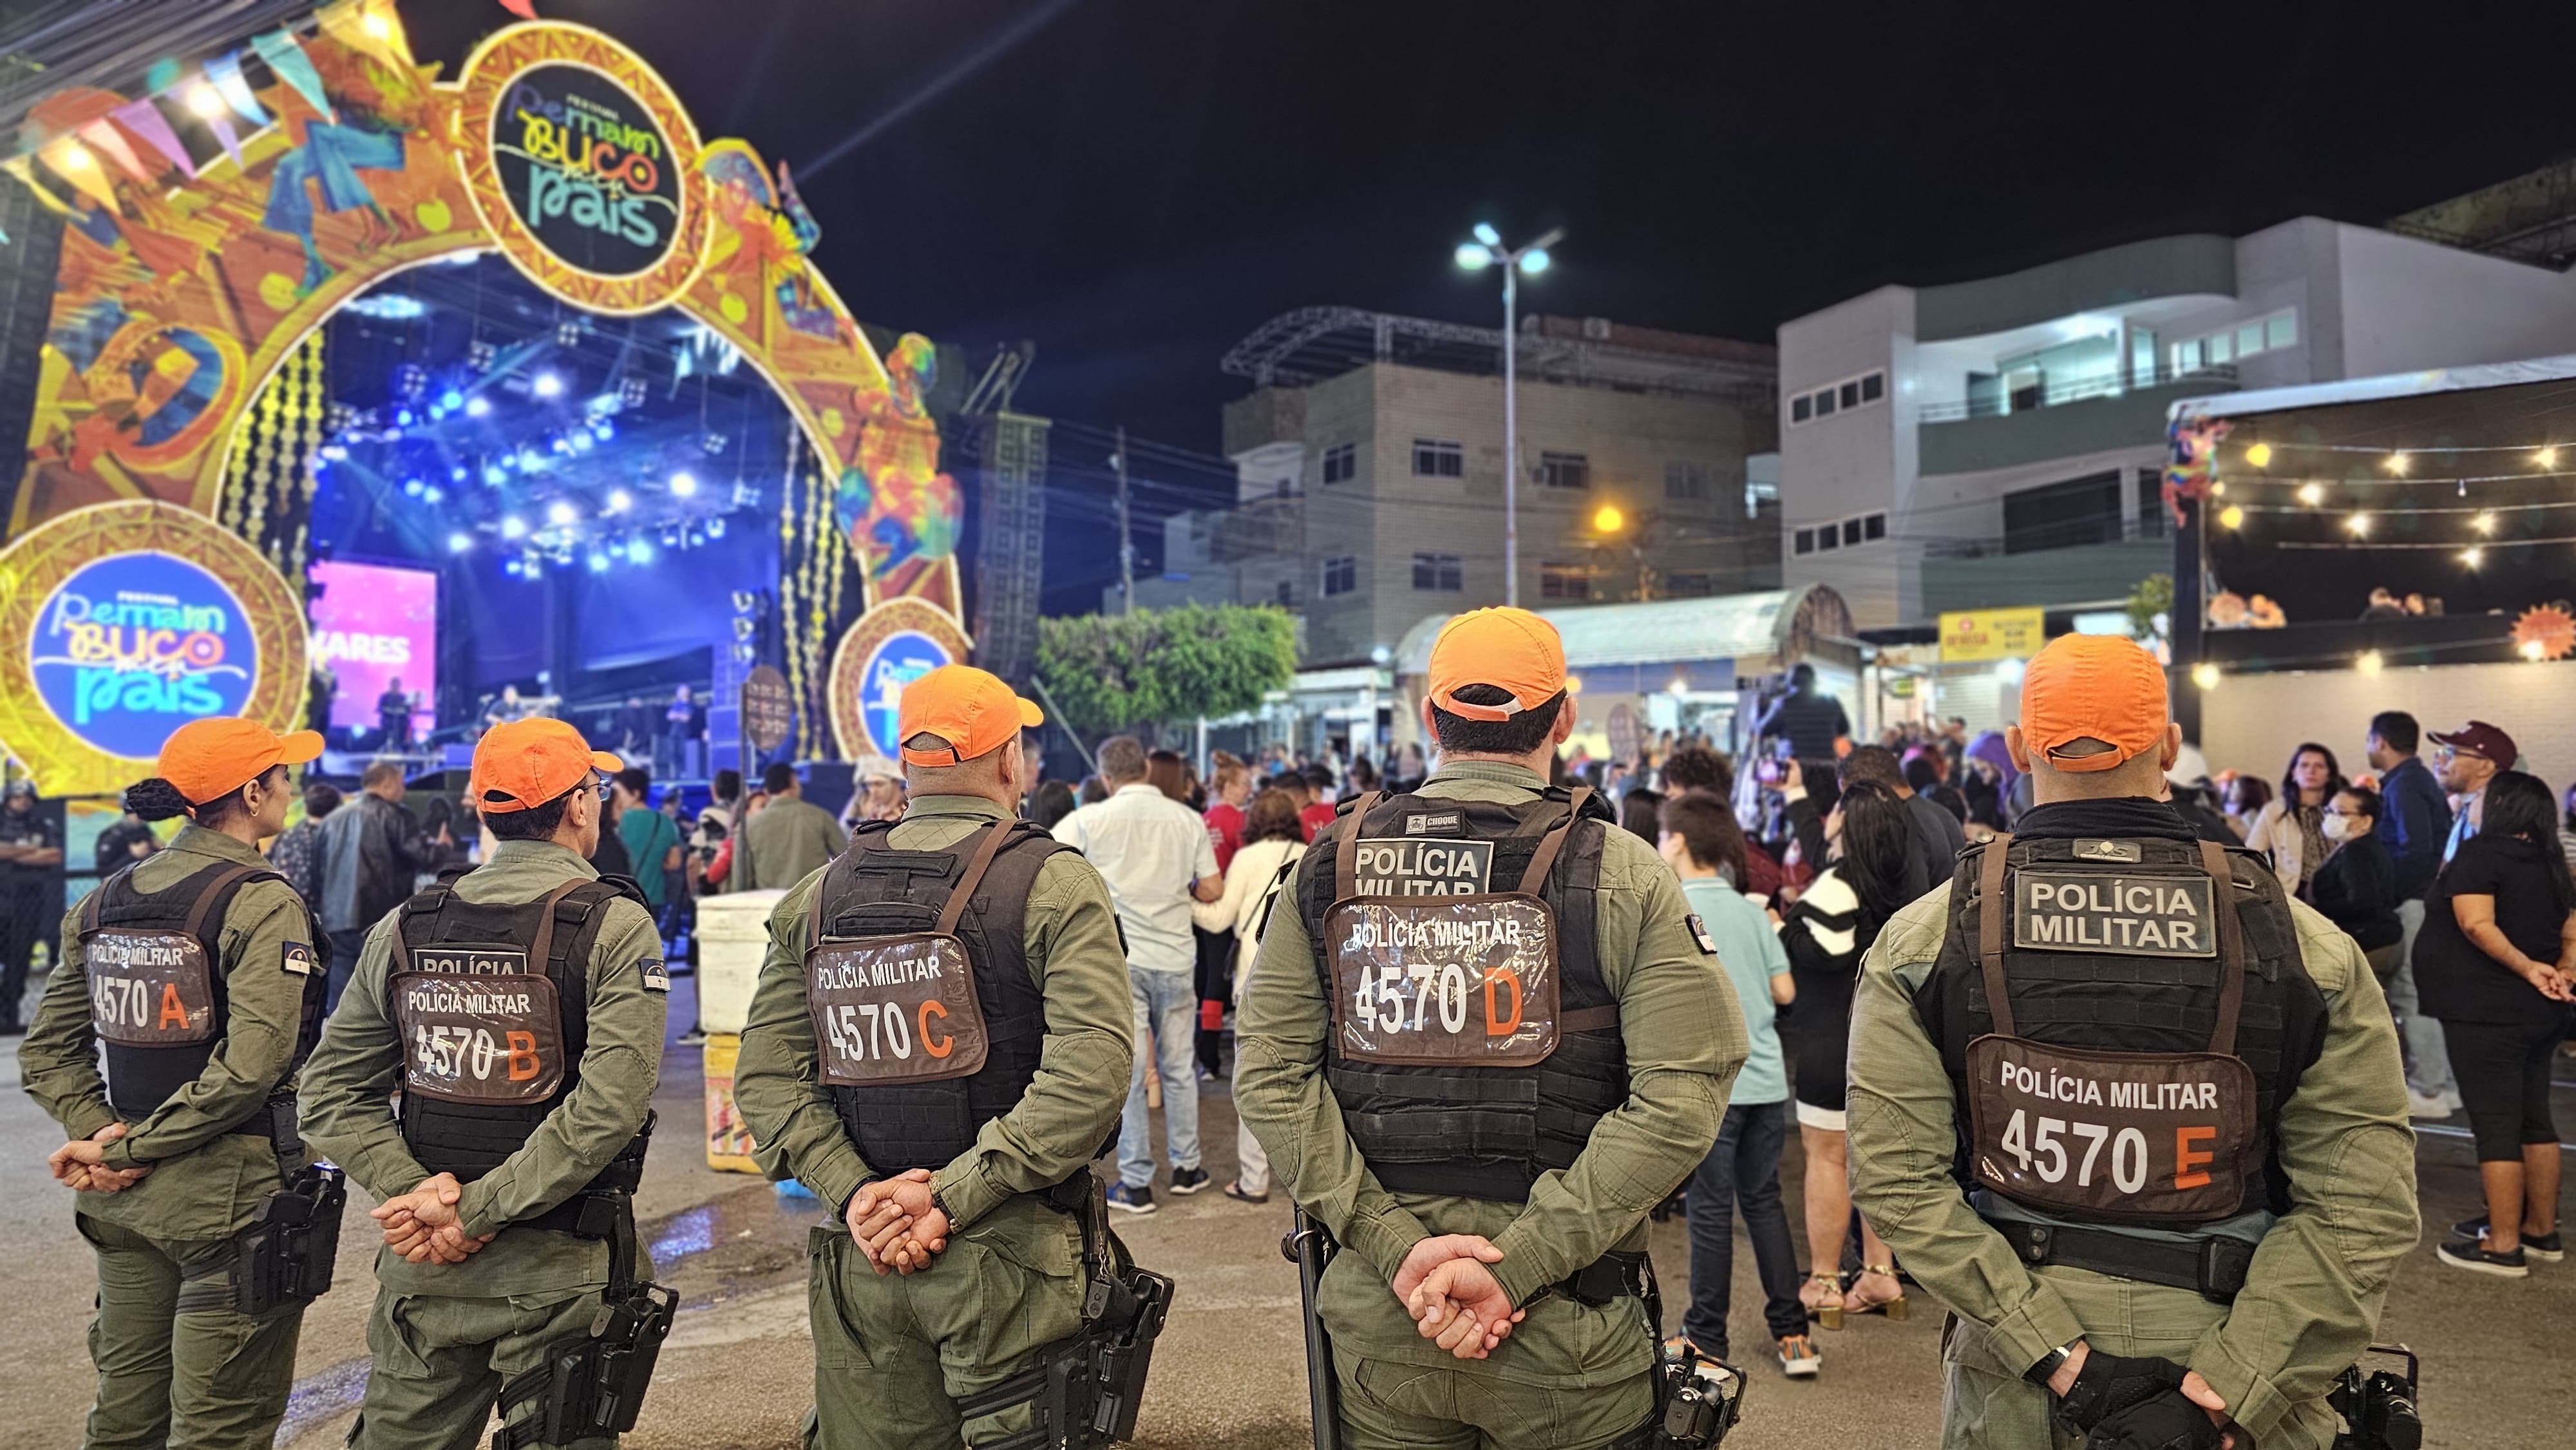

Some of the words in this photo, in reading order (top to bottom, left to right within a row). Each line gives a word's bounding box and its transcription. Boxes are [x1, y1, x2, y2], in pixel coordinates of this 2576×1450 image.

[1355, 842, 1478, 878] POLÍCIA
[1355, 879, 1475, 897] MILITAR
[2031, 880, 2197, 916] POLÍCIA
[1352, 916, 1429, 948] POLÍCIA
[1432, 919, 1521, 948] MILITAR
[2031, 915, 2197, 950] MILITAR
[129, 946, 184, 966] MILITAR
[423, 956, 514, 975] POLÍCIA
[818, 962, 870, 990] POLÍCIA
[871, 956, 942, 987] MILITAR
[95, 974, 148, 1028] 4570
[159, 983, 191, 1030] A
[409, 990, 463, 1013] POLÍCIA
[464, 993, 531, 1014] MILITAR
[1355, 963, 1467, 1034] 4570
[1484, 967, 1522, 1036] D
[826, 1001, 911, 1061] 4570
[918, 999, 953, 1058] C
[416, 1024, 495, 1080] 4570
[506, 1030, 540, 1081] B
[2001, 1060, 2103, 1106] POLÍCIA
[2110, 1082, 2217, 1111] MILITAR
[2001, 1108, 2148, 1194] 4570
[2174, 1125, 2216, 1189] E
